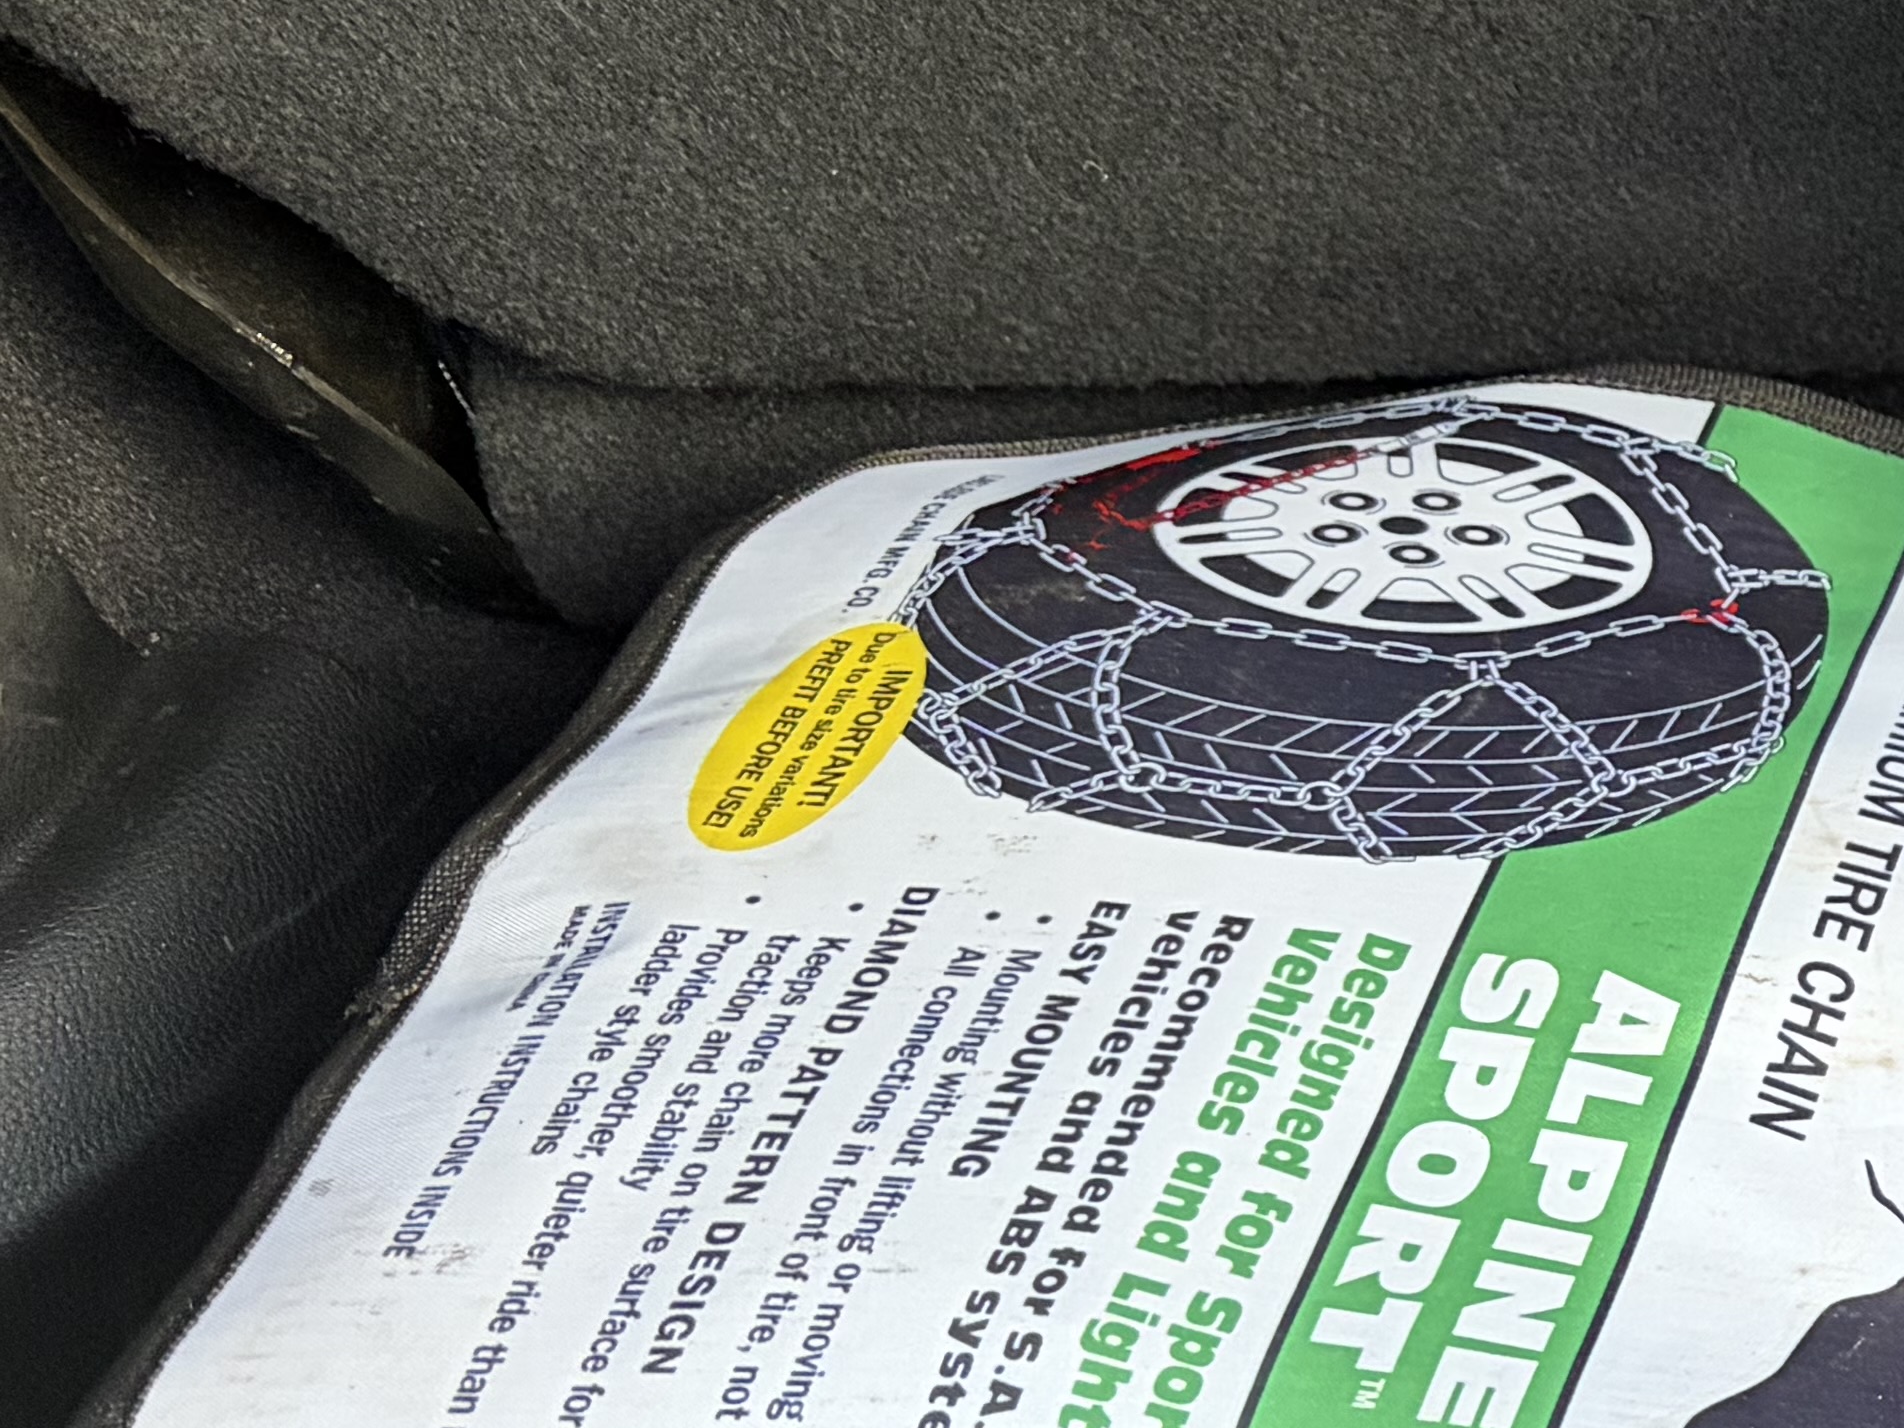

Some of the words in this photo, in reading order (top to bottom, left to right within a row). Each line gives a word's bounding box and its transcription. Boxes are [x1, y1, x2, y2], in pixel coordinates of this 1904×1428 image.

[893, 502, 946, 542] CHAIN
[841, 585, 880, 613] CO.
[792, 638, 852, 703] PREFIT
[844, 667, 872, 683] to
[857, 631, 897, 664] Due
[796, 670, 912, 807] IMPORTANT!
[799, 718, 833, 751] size
[823, 687, 858, 715] tire
[735, 705, 808, 782] BEFORE
[702, 785, 753, 828] USE!
[738, 755, 809, 837] variations
[1812, 841, 1903, 952] TIRE
[525, 901, 630, 1027] INSTALLATION
[628, 923, 700, 996] ladder
[655, 927, 749, 1026] Provides
[716, 934, 801, 1022] traction
[779, 936, 851, 1006] Keeps
[822, 886, 940, 1034] DIAMOND
[942, 946, 987, 977] All
[1057, 900, 1131, 985] EASY
[587, 1004, 641, 1062] style
[941, 948, 1042, 1065] Mounting
[1086, 910, 1200, 1077] vehicles
[1197, 927, 1341, 1136] Vehicles
[684, 1029, 732, 1074] and
[737, 1013, 795, 1073] more
[851, 985, 958, 1133] connections
[1060, 914, 1254, 1234] Recommended
[1257, 932, 1412, 1179] Designed
[1748, 960, 1855, 1141] CHAIN
[431, 1033, 546, 1177] INSTRUCTIONS
[530, 1070, 599, 1155] chains
[573, 1033, 672, 1159] smoother,
[691, 1081, 753, 1152] chain
[723, 1045, 844, 1205] PATTERN
[890, 1071, 967, 1167] without
[947, 993, 1080, 1177] MOUNTING
[618, 1082, 701, 1192] stability
[832, 1143, 874, 1166] in
[1034, 1089, 1102, 1174] and
[669, 1162, 708, 1196] on
[792, 1176, 857, 1241] front
[835, 1175, 915, 1254] lifting
[1135, 1150, 1221, 1262] and
[381, 1184, 451, 1259] INSIDE
[521, 1170, 593, 1271] quieter
[641, 1205, 694, 1253] tire
[985, 1184, 1057, 1276] ABS
[1214, 1189, 1293, 1279] for
[487, 1279, 541, 1333] ride
[640, 1220, 746, 1374] DESIGN
[774, 1252, 809, 1283] of
[826, 1262, 861, 1293] or
[1022, 1246, 1087, 1316] for
[580, 1262, 656, 1373] surface
[736, 1290, 799, 1352] tire,
[446, 1342, 508, 1414] than
[714, 1365, 759, 1420] not
[765, 1303, 844, 1422] moving
[558, 1383, 605, 1428] for
